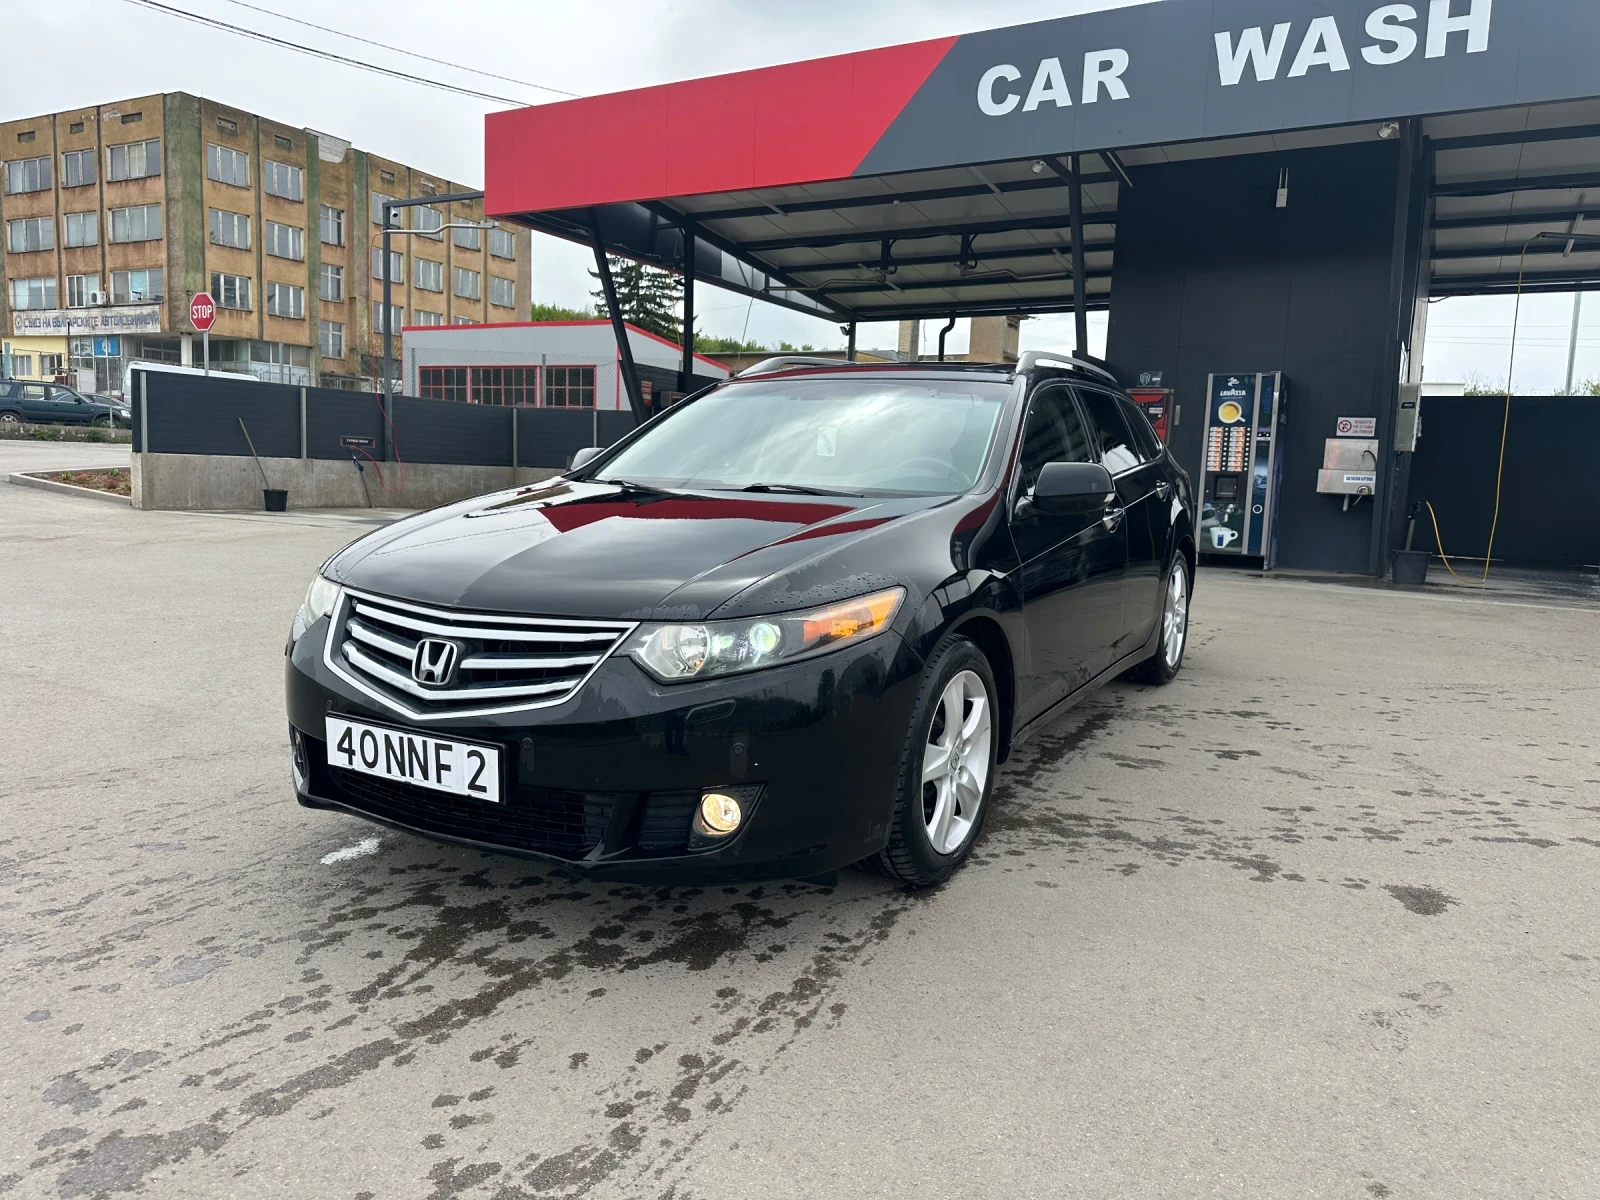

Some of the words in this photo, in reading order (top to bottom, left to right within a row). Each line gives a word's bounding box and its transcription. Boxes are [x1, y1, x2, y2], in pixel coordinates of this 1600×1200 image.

[976, 48, 1130, 116] CAR
[1214, 0, 1492, 86] WASH
[192, 305, 212, 319] STOP
[43, 317, 51, 328] НА
